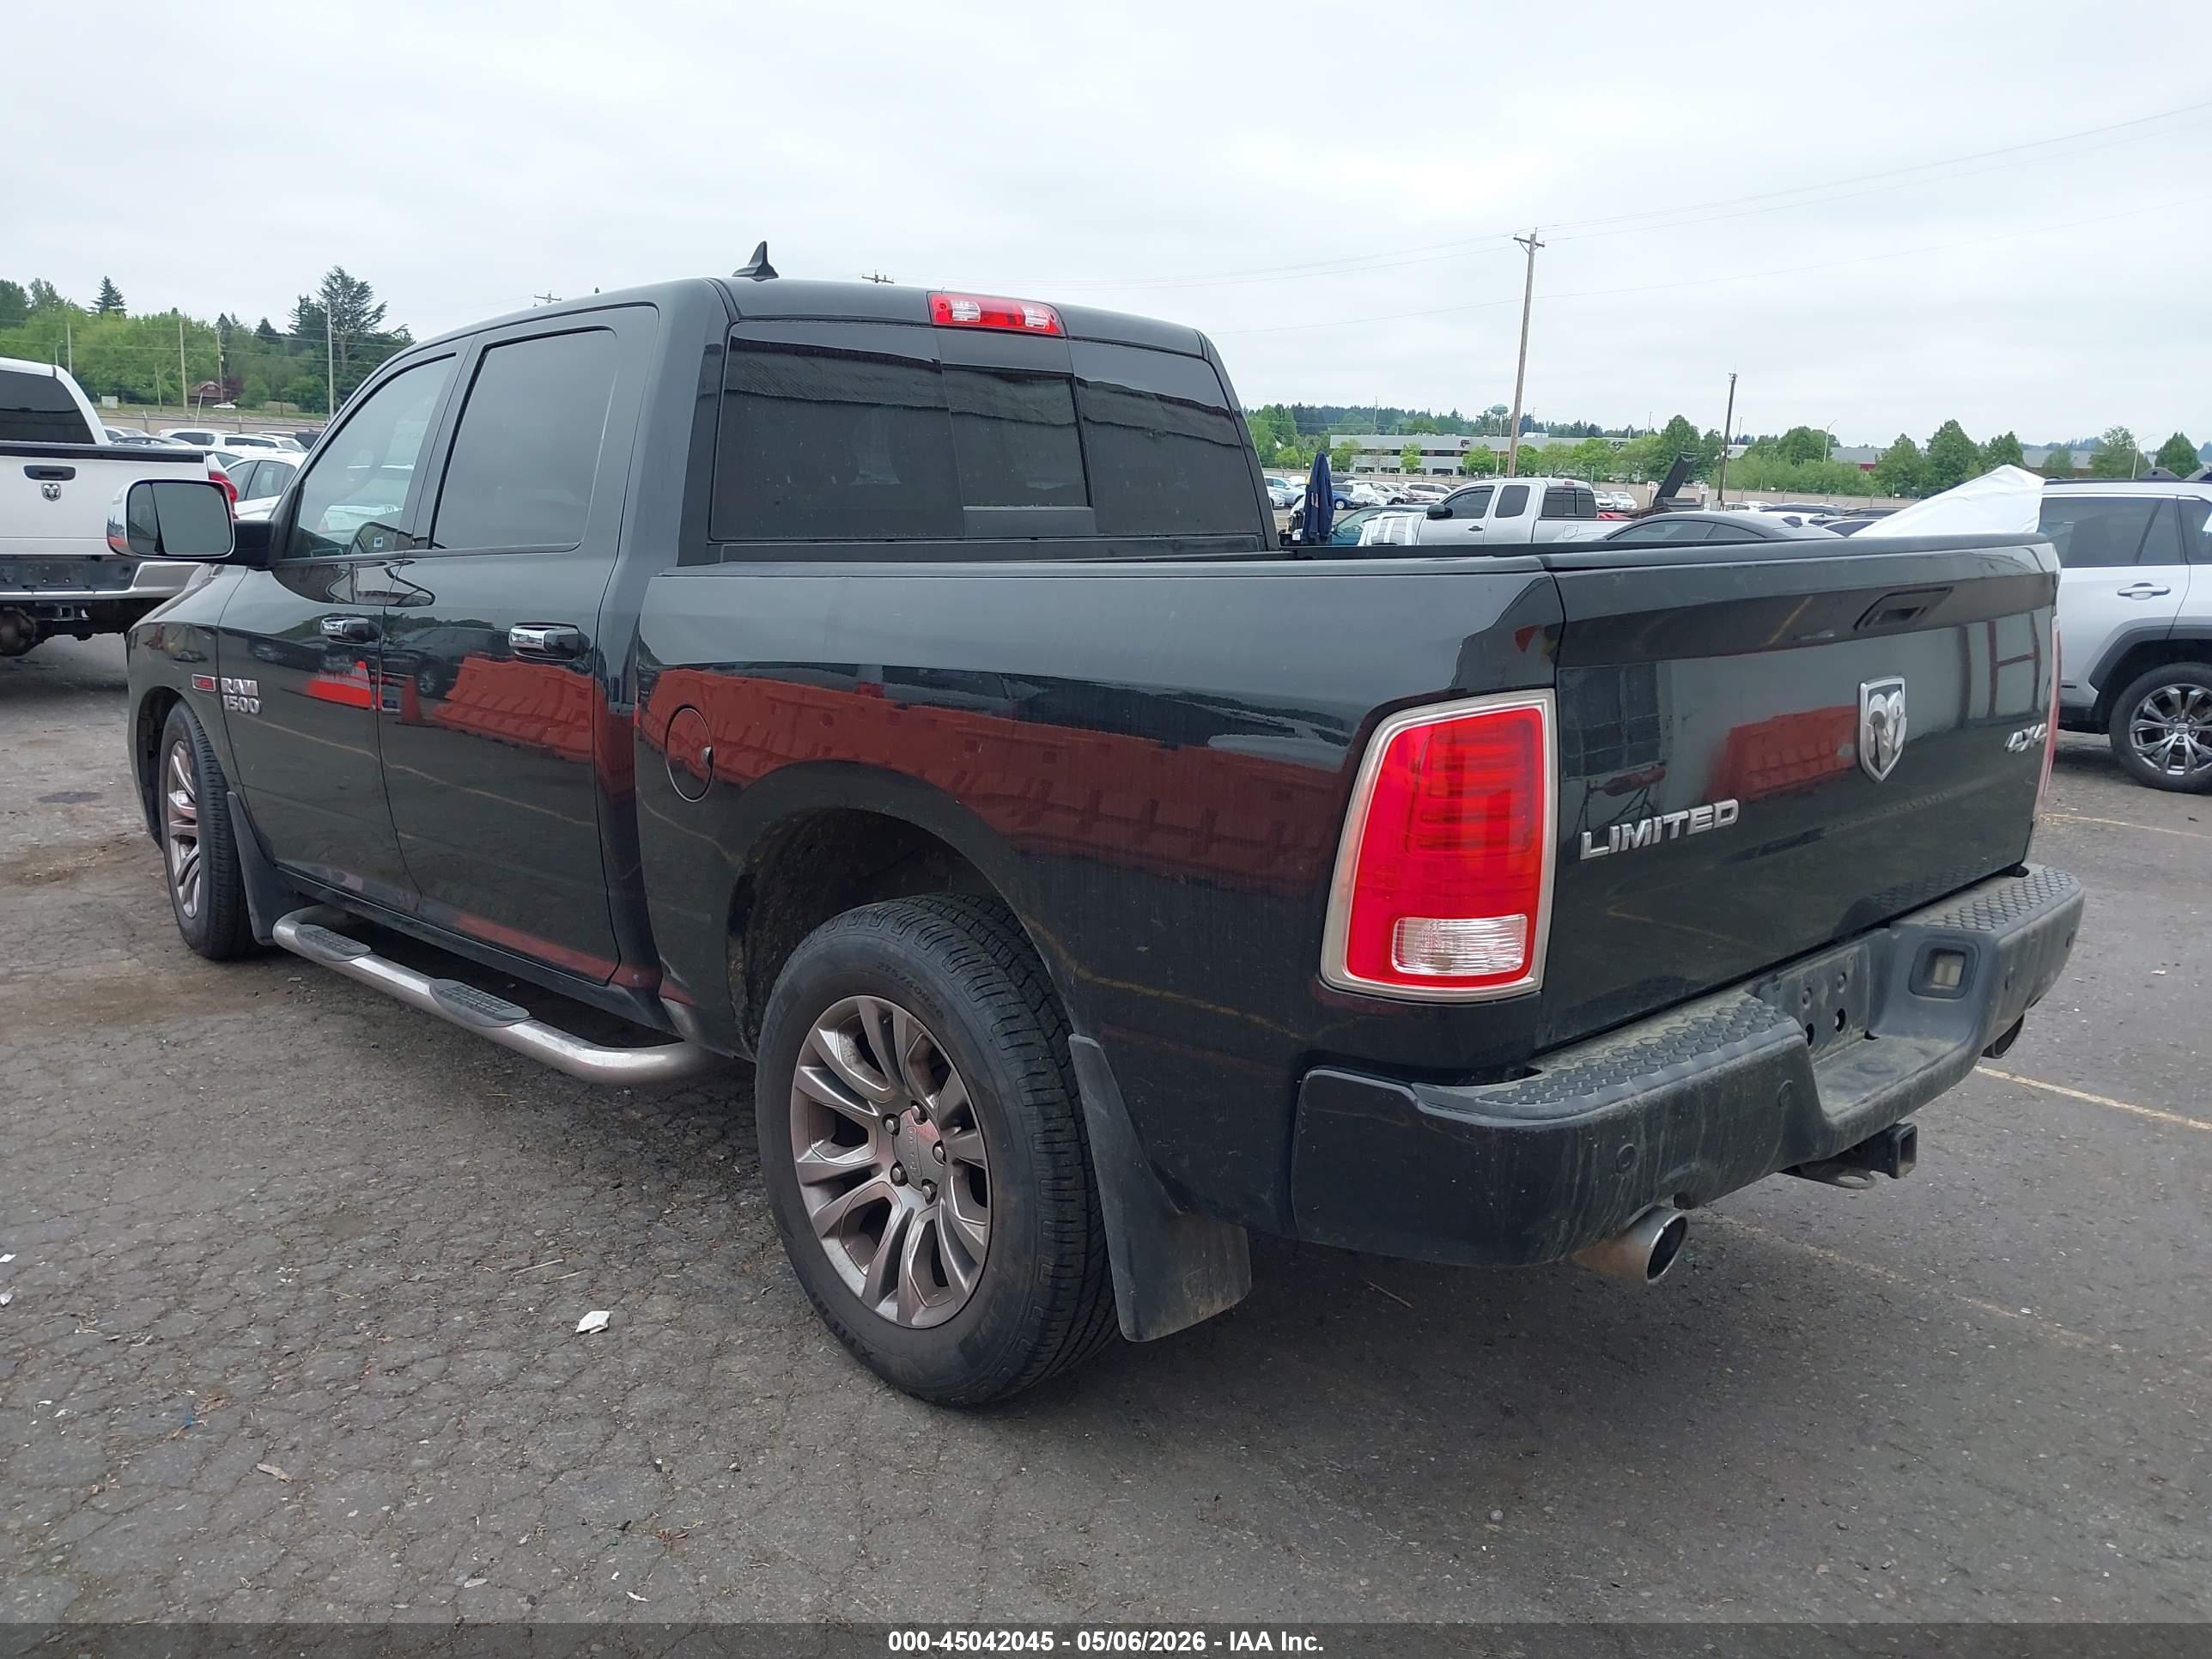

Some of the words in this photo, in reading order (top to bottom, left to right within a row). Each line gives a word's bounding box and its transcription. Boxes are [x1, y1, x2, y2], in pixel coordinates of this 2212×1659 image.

[221, 677, 258, 696] RAM
[222, 695, 261, 714] 1500
[1580, 799, 1740, 860] LIMITED
